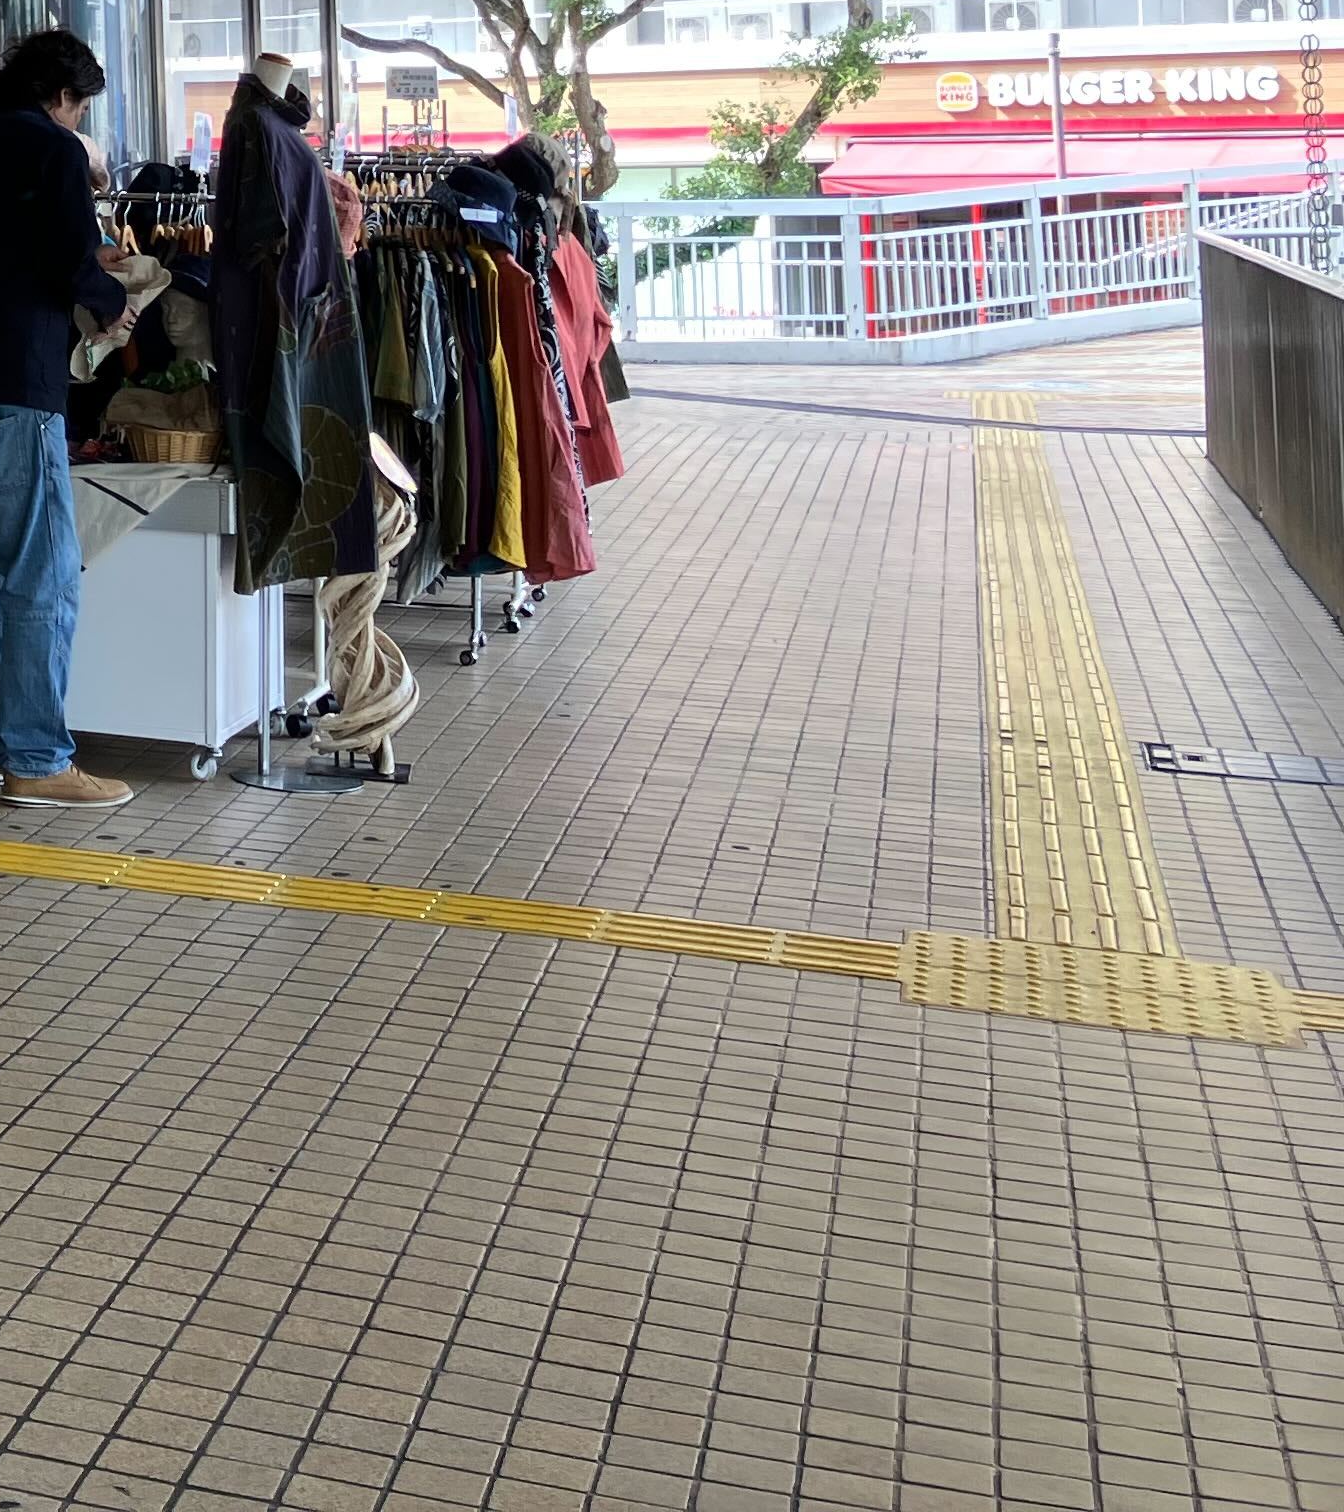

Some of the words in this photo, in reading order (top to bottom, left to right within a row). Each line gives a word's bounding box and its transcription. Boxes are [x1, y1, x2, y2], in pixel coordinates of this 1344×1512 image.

[940, 92, 973, 101] KING
[987, 70, 1156, 107] BURGER
[1165, 65, 1281, 104] KING
